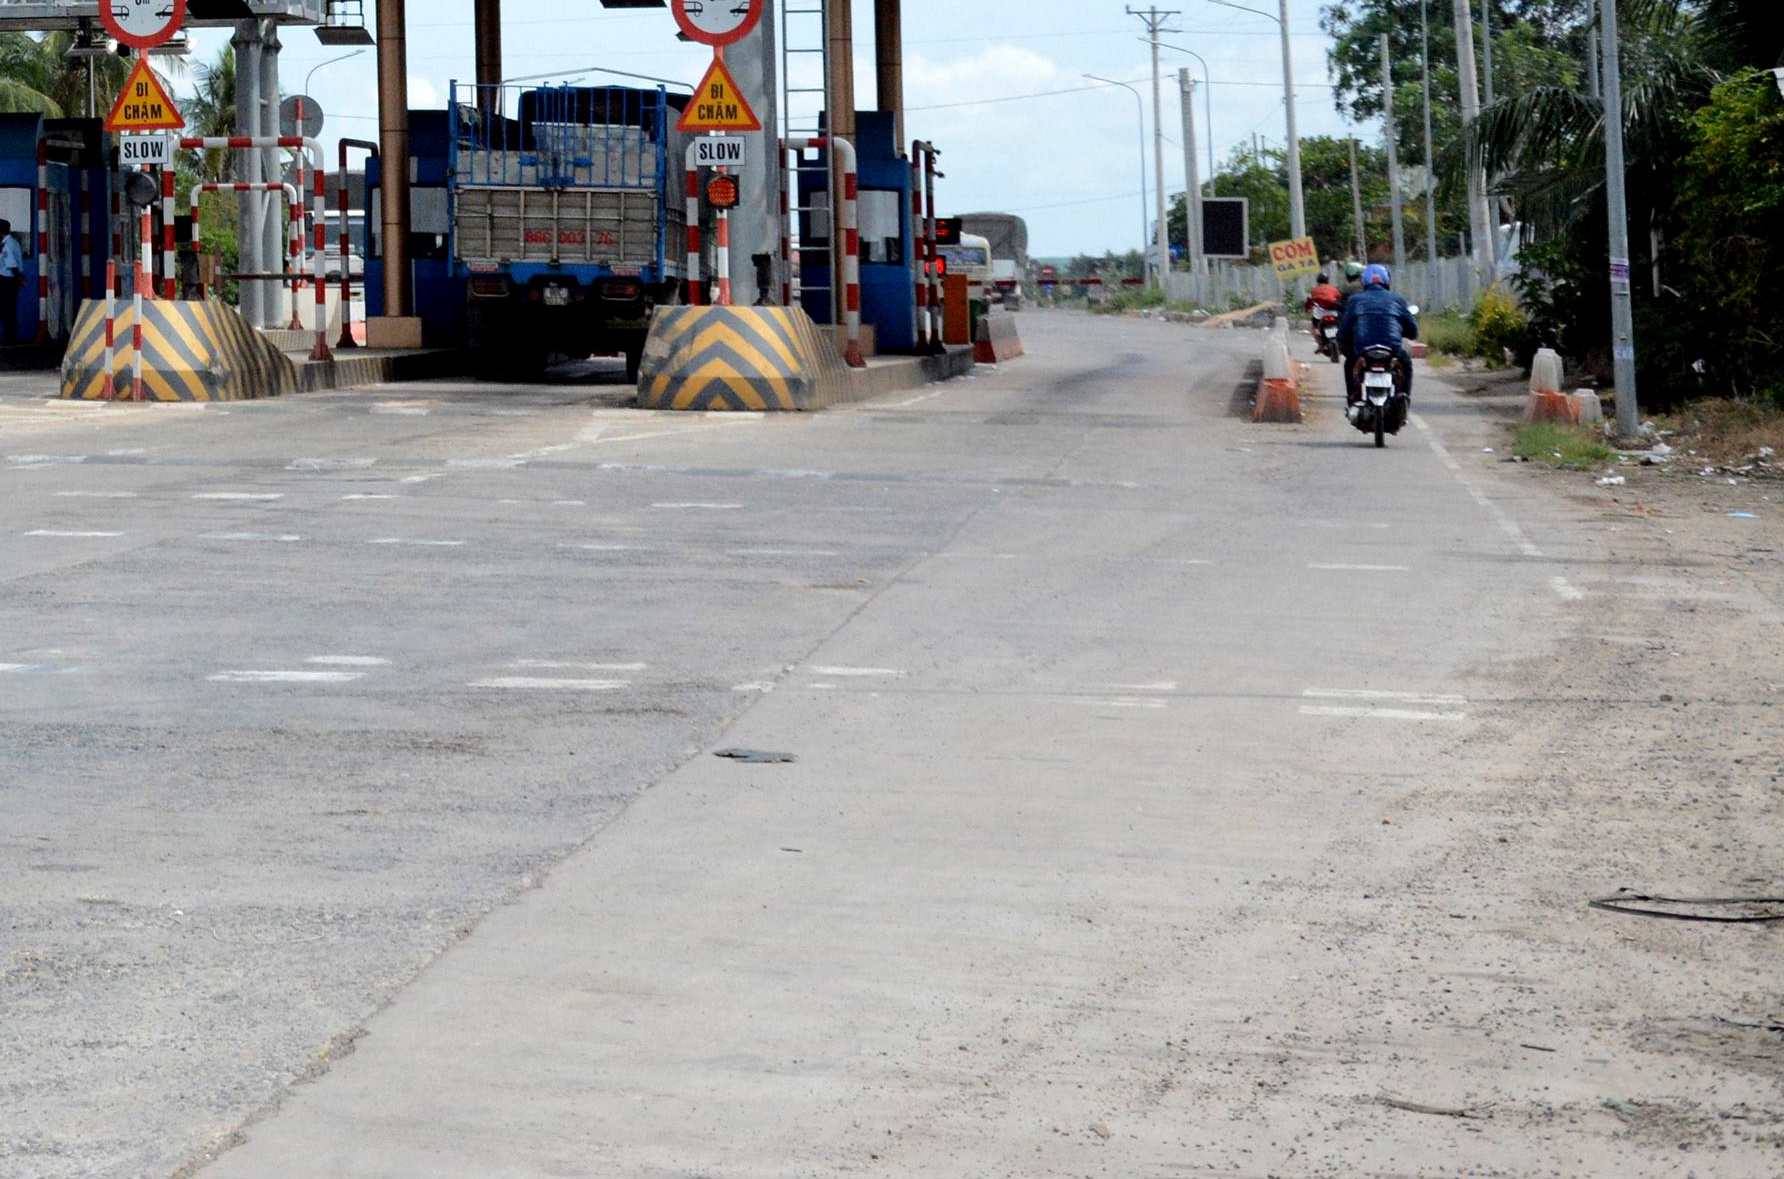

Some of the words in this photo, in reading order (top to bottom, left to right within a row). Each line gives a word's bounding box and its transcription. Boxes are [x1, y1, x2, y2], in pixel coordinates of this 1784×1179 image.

[135, 81, 149, 97] ĐI
[710, 83, 724, 100] ĐI
[124, 101, 163, 123] CHẬM
[697, 101, 738, 124] CHẬM
[124, 141, 164, 159] SLOW
[699, 142, 741, 161] SLOW
